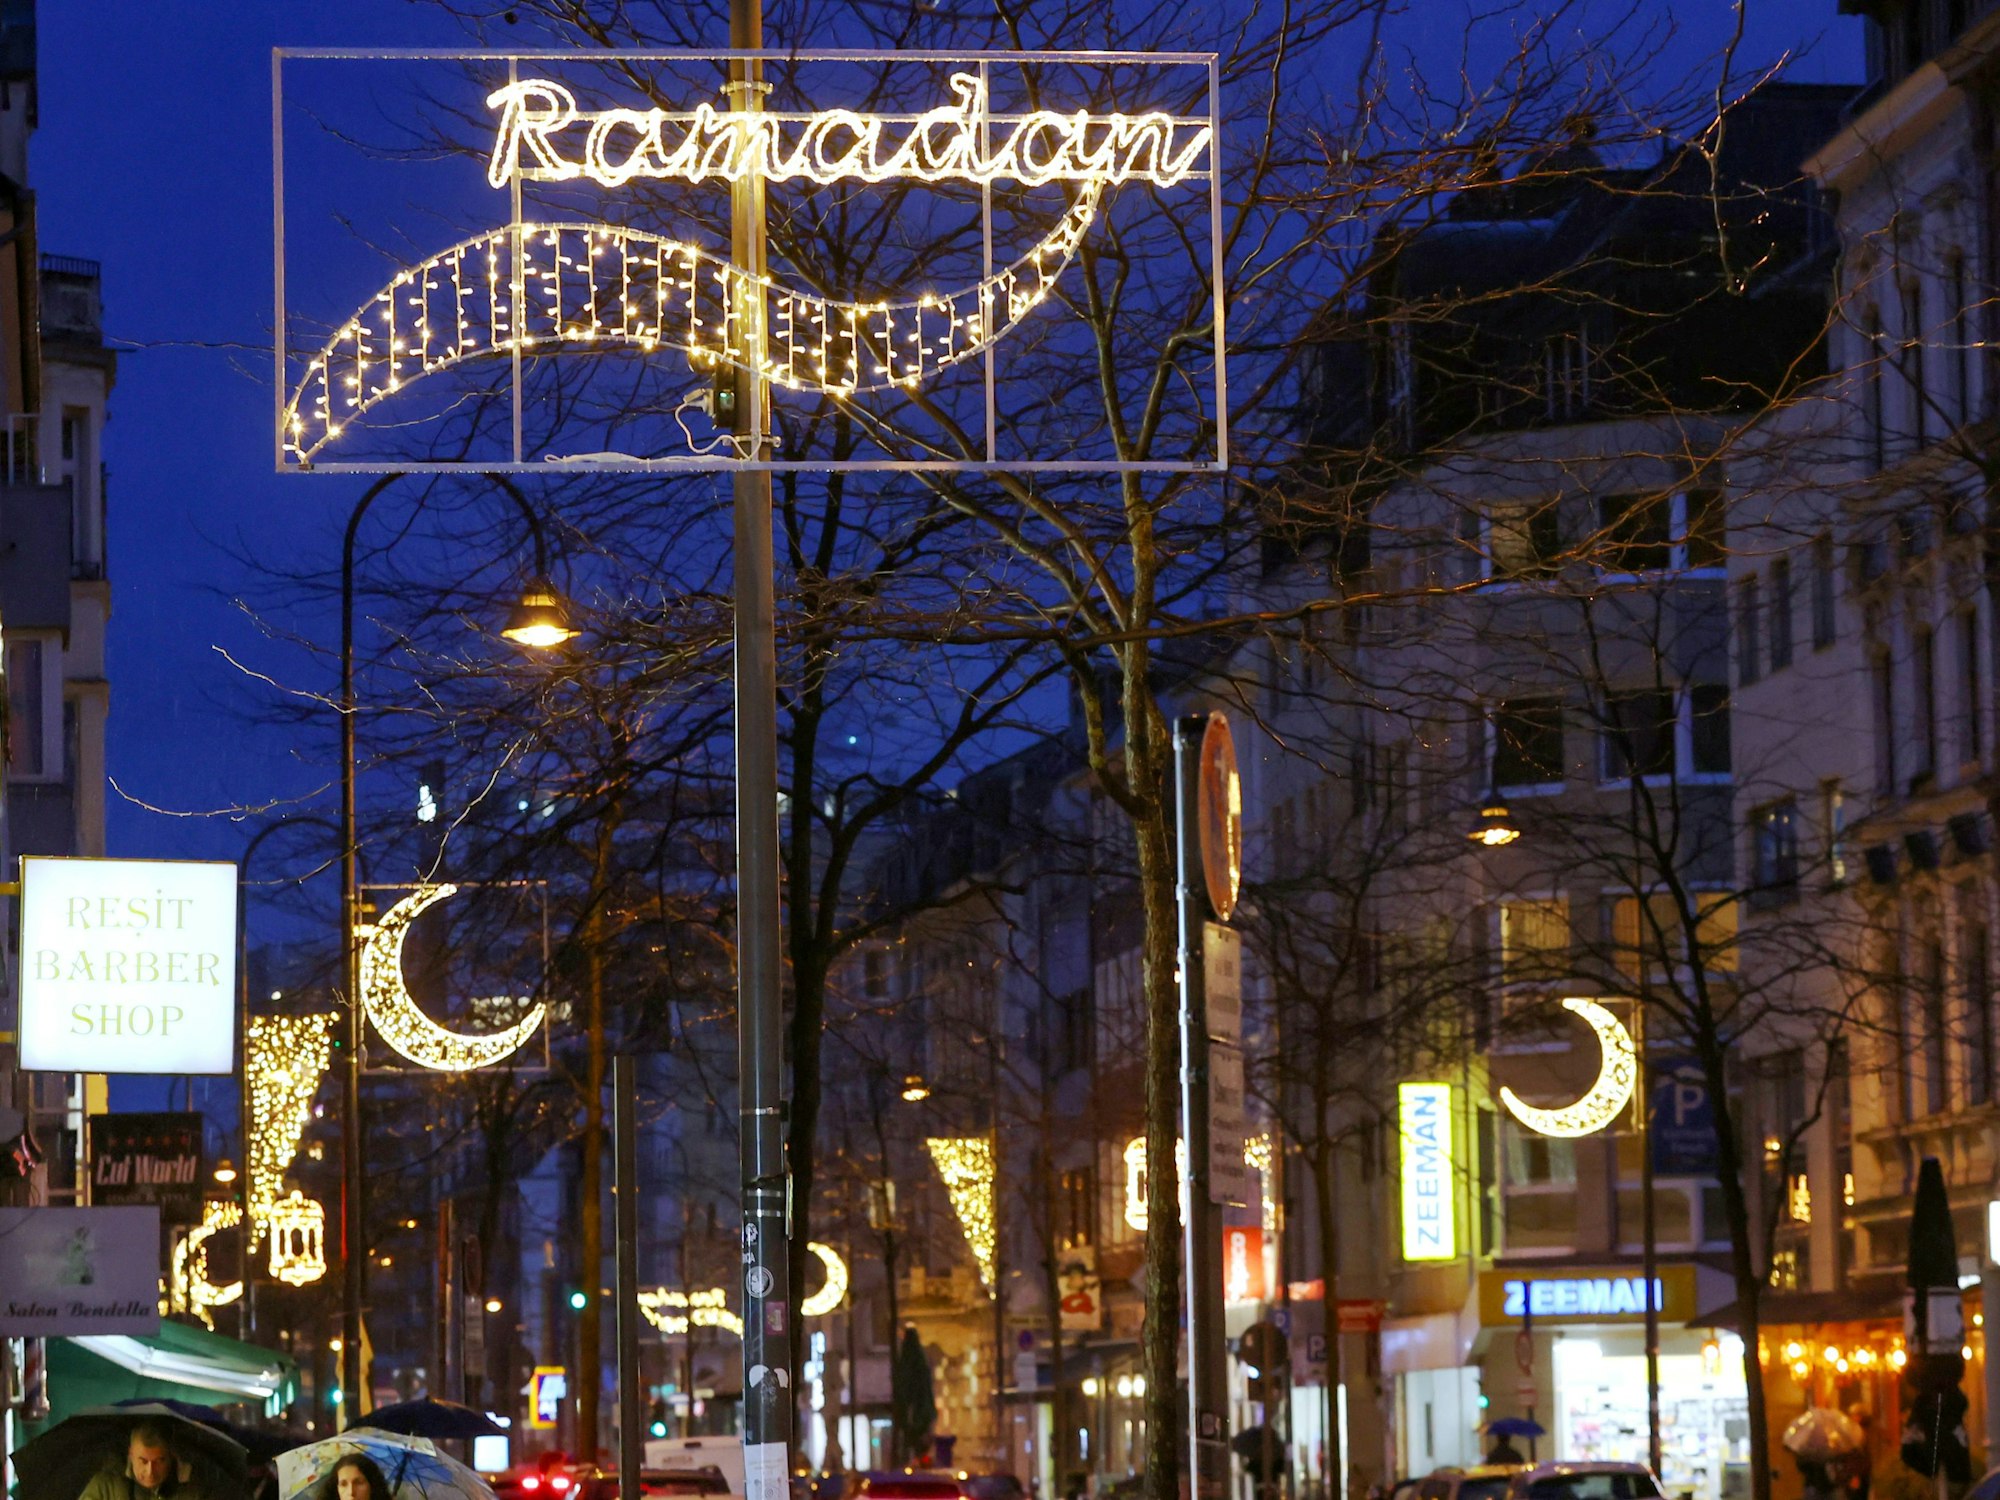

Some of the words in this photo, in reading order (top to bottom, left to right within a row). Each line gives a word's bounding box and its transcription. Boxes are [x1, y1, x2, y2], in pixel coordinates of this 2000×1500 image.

[486, 72, 1213, 188] Ramadan
[34, 949, 220, 986] BARBER
[70, 1003, 184, 1036] SHOP
[135, 1154, 197, 1184] World
[1413, 1095, 1441, 1245] ZEEMAN
[4, 1301, 58, 1318] Salon
[66, 1301, 150, 1317] Bendella
